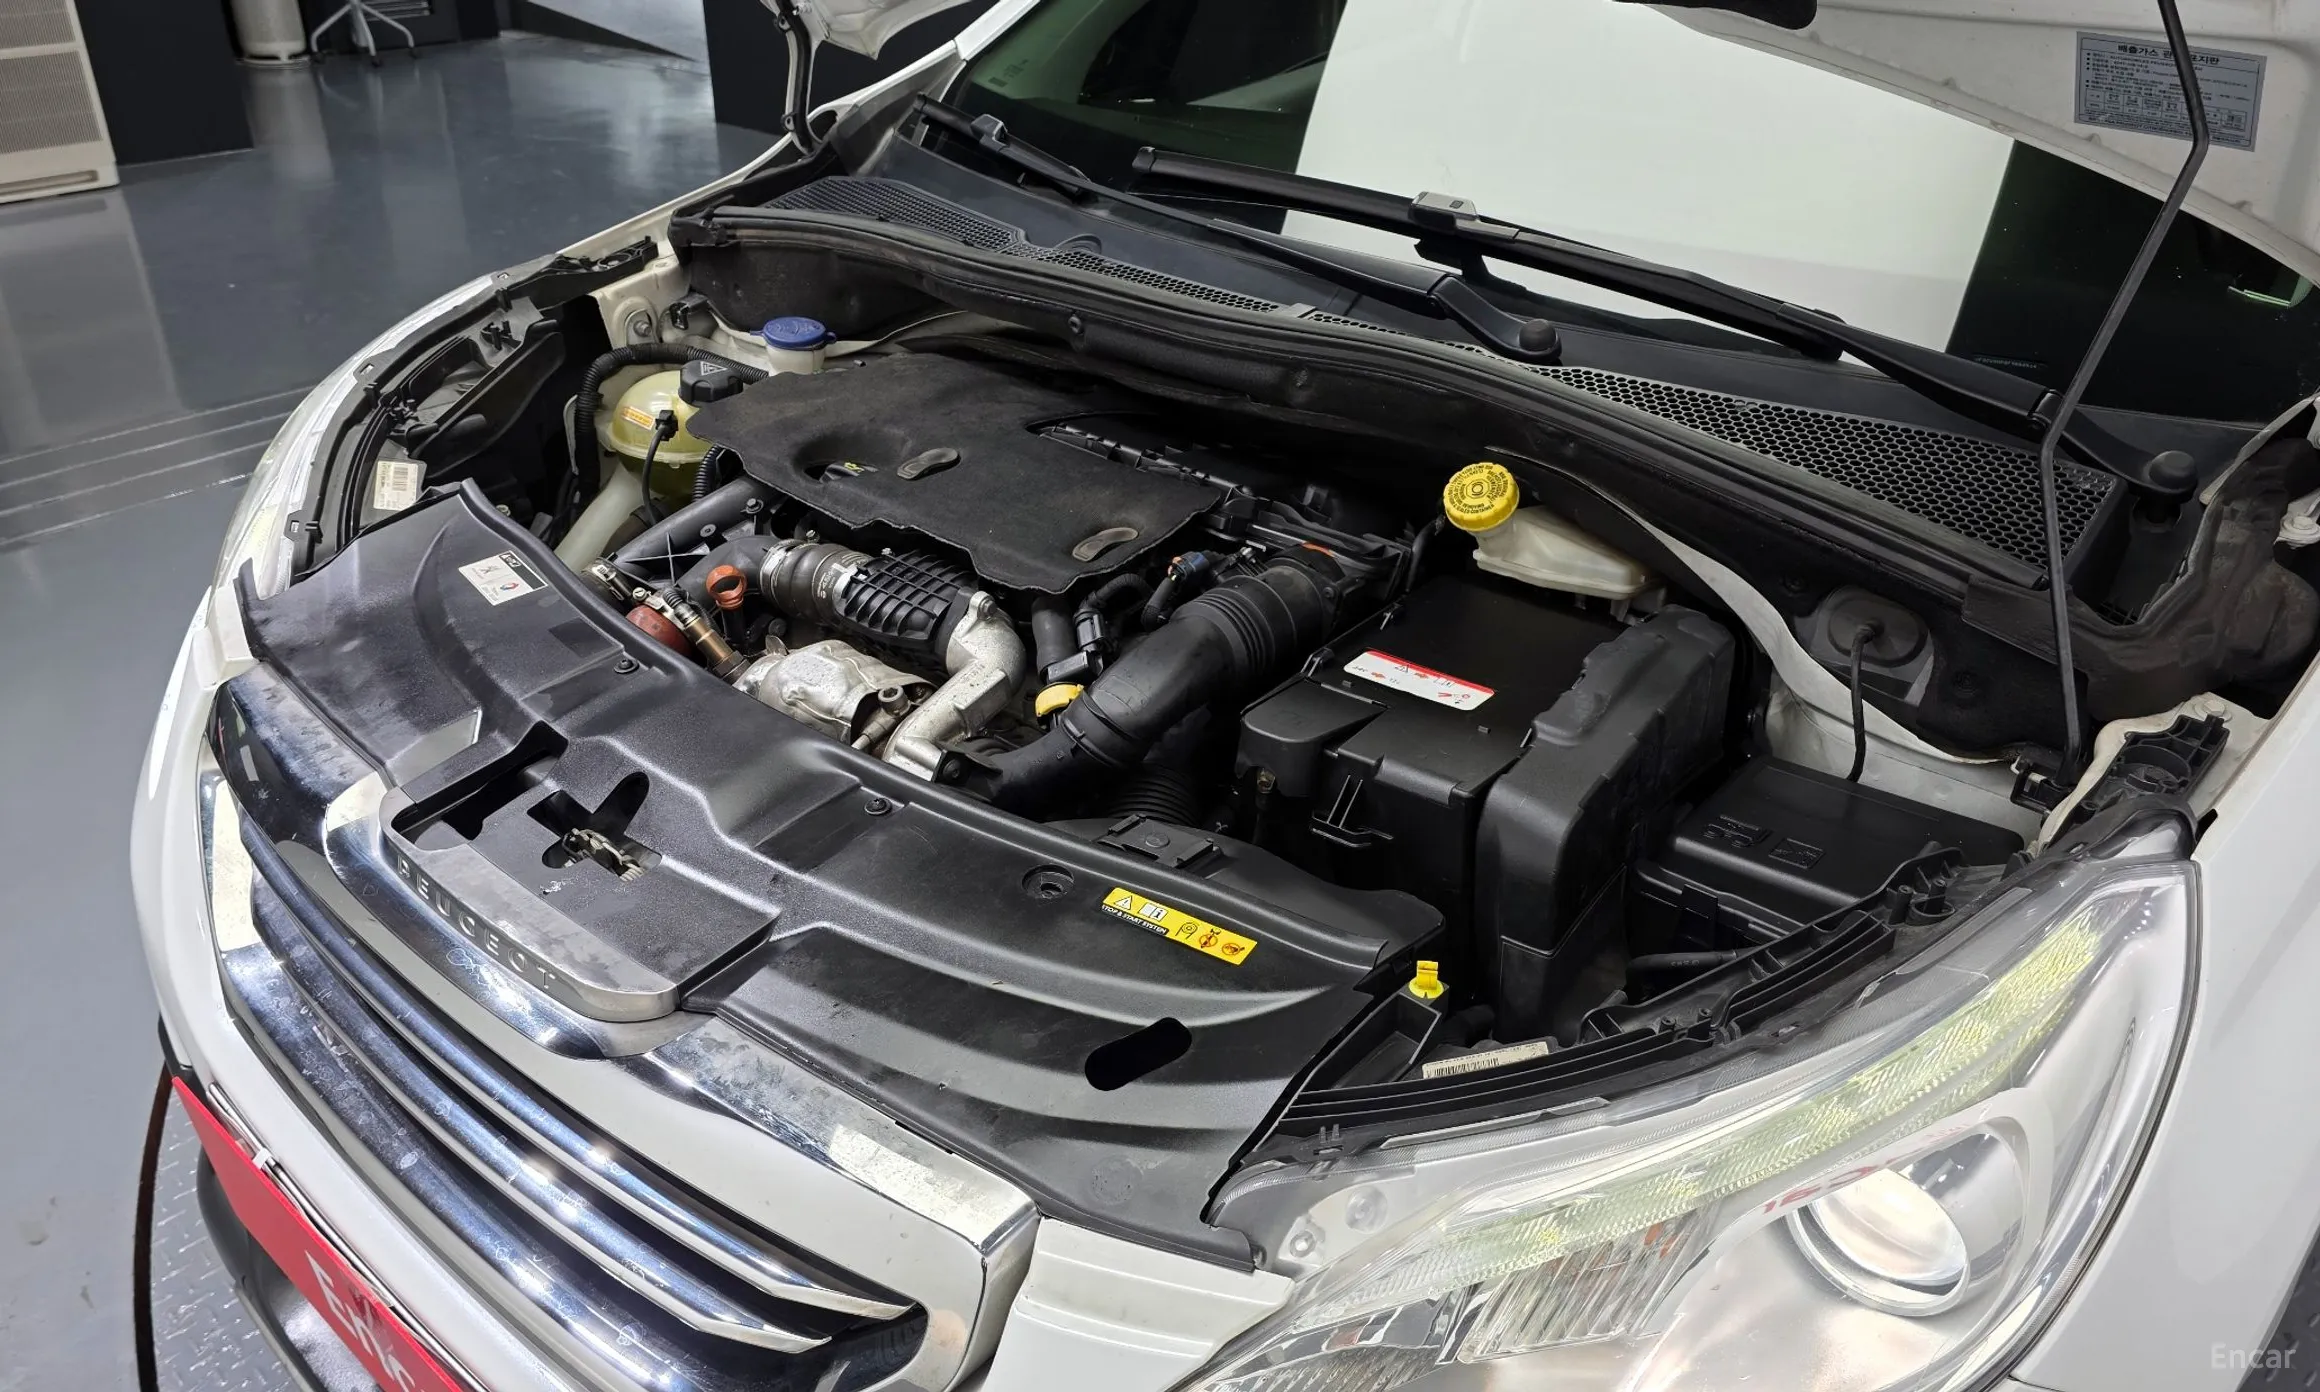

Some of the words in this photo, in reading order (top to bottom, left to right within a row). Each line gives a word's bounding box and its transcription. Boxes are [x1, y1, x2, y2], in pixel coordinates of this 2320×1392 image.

[2118, 44, 2159, 57] 배출가스
[397, 855, 556, 989] PEUGEOT
[1102, 905, 1116, 913] STOP
[1122, 913, 1142, 925] START
[1142, 922, 1166, 934] SYSTEM
